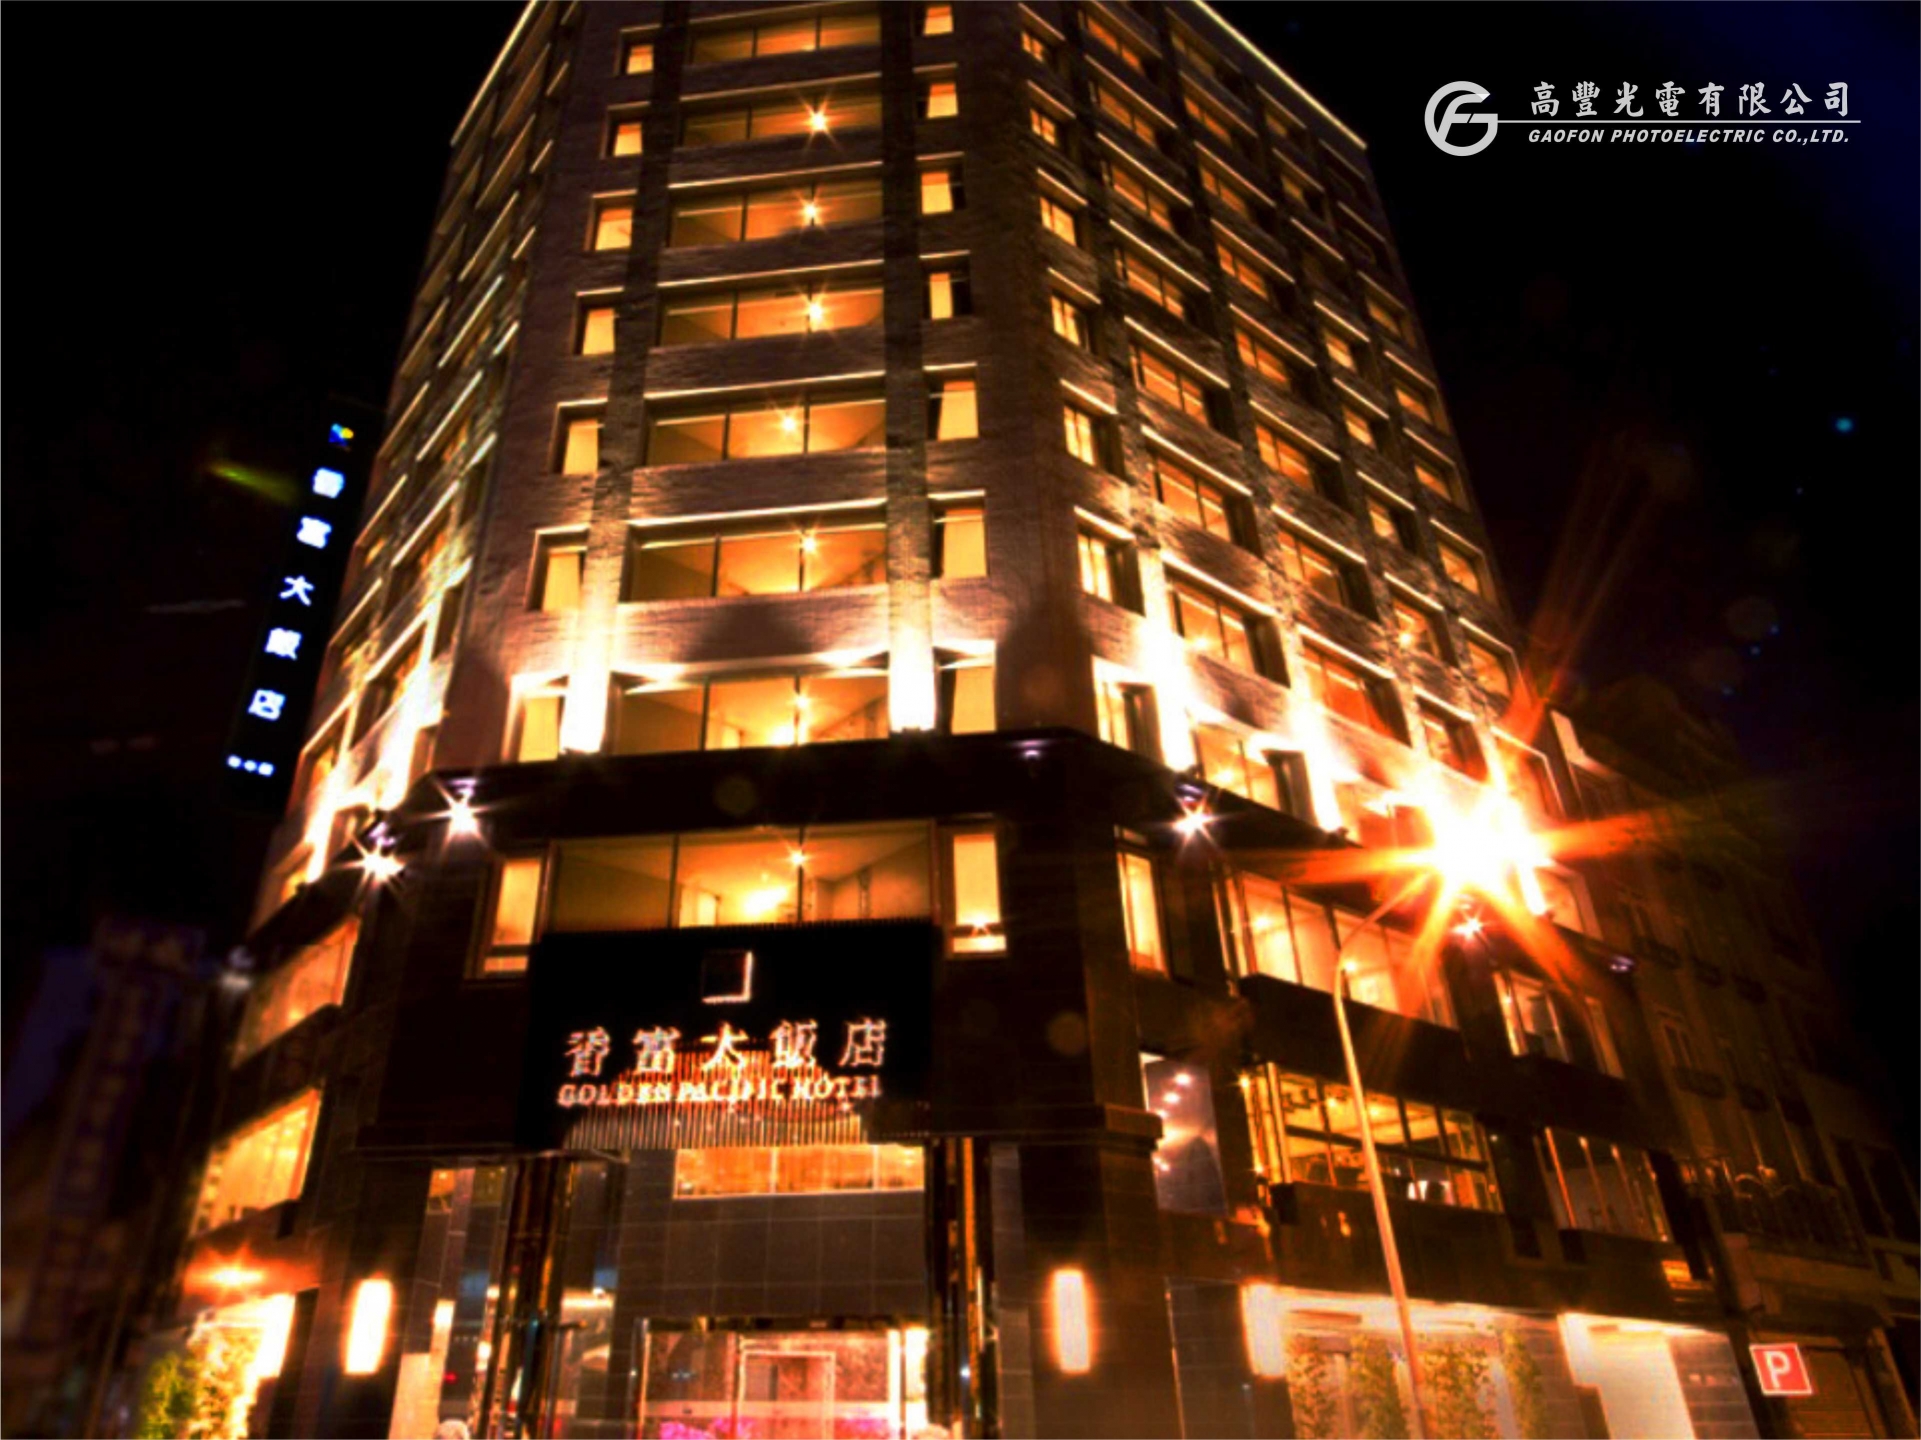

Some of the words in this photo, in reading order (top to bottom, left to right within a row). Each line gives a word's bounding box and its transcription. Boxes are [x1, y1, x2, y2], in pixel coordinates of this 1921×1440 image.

[565, 1016, 887, 1077] 香富大飯店
[558, 1083, 672, 1107] GOLDEN
[1764, 1350, 1791, 1389] P
